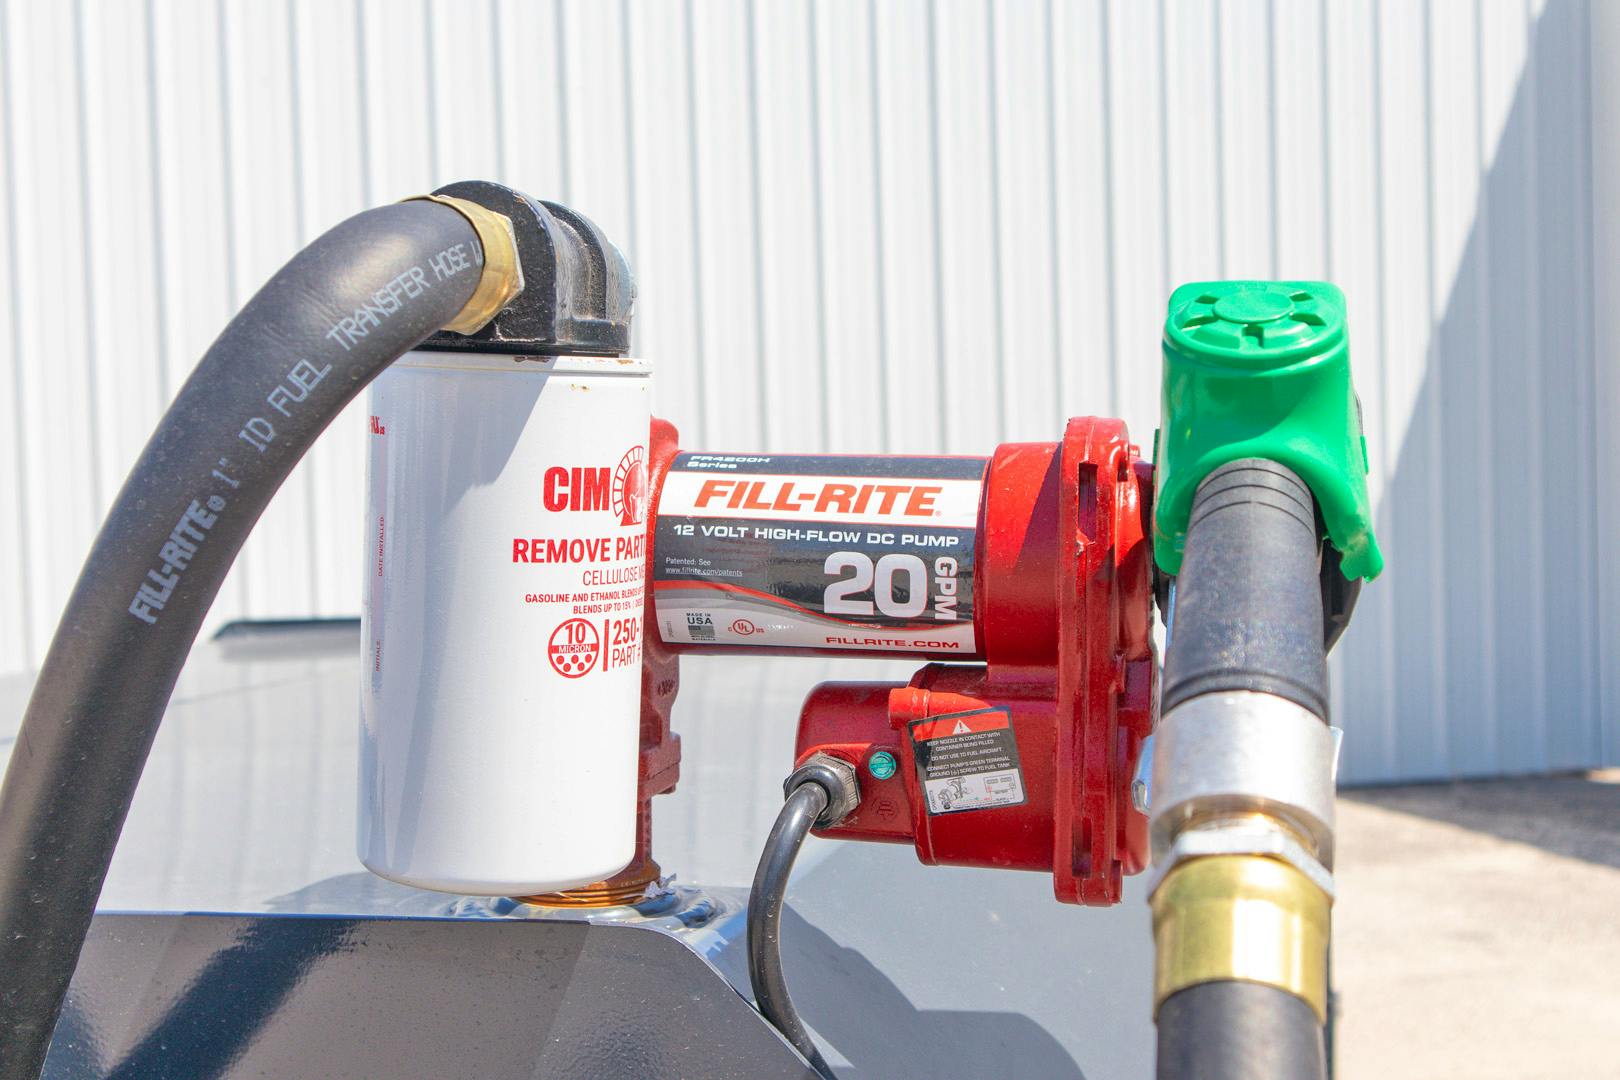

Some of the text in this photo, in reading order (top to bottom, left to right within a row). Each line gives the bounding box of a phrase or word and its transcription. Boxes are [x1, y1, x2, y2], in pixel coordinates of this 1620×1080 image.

[238, 415, 278, 454] ID
[266, 358, 333, 418] FUEL
[325, 264, 431, 352] TRANSFER
[429, 242, 472, 284] HOSE
[687, 461, 738, 469] Series
[543, 466, 611, 513] CIM
[672, 524, 960, 548] 12 VOLT HIGH-FLOW DC PUMP
[512, 537, 611, 563] REMOVE
[698, 558, 712, 566] See
[582, 566, 637, 586] CELLULOSE
[824, 551, 958, 620] 20 GPM
[525, 593, 570, 603] GASOLINE
[572, 592, 588, 602] AND
[590, 590, 621, 602] ETHANOL
[573, 604, 603, 615] BLENDS
[603, 603, 613, 613] UP
[613, 602, 622, 612] TO
[687, 617, 713, 625] USA
[565, 622, 586, 645] 10
[558, 644, 592, 654] MICRON
[825, 636, 959, 649] FILLRITE.COM
[612, 644, 637, 669] PART
[964, 733, 987, 741] CONTACT
[935, 743, 963, 752] CONTAINER
[979, 747, 1002, 755] AIRCRAFT
[927, 764, 950, 772] CONNECT
[986, 756, 1010, 764] TERMINAL
[929, 770, 950, 778] GROUND
[959, 766, 977, 774] SCREW
